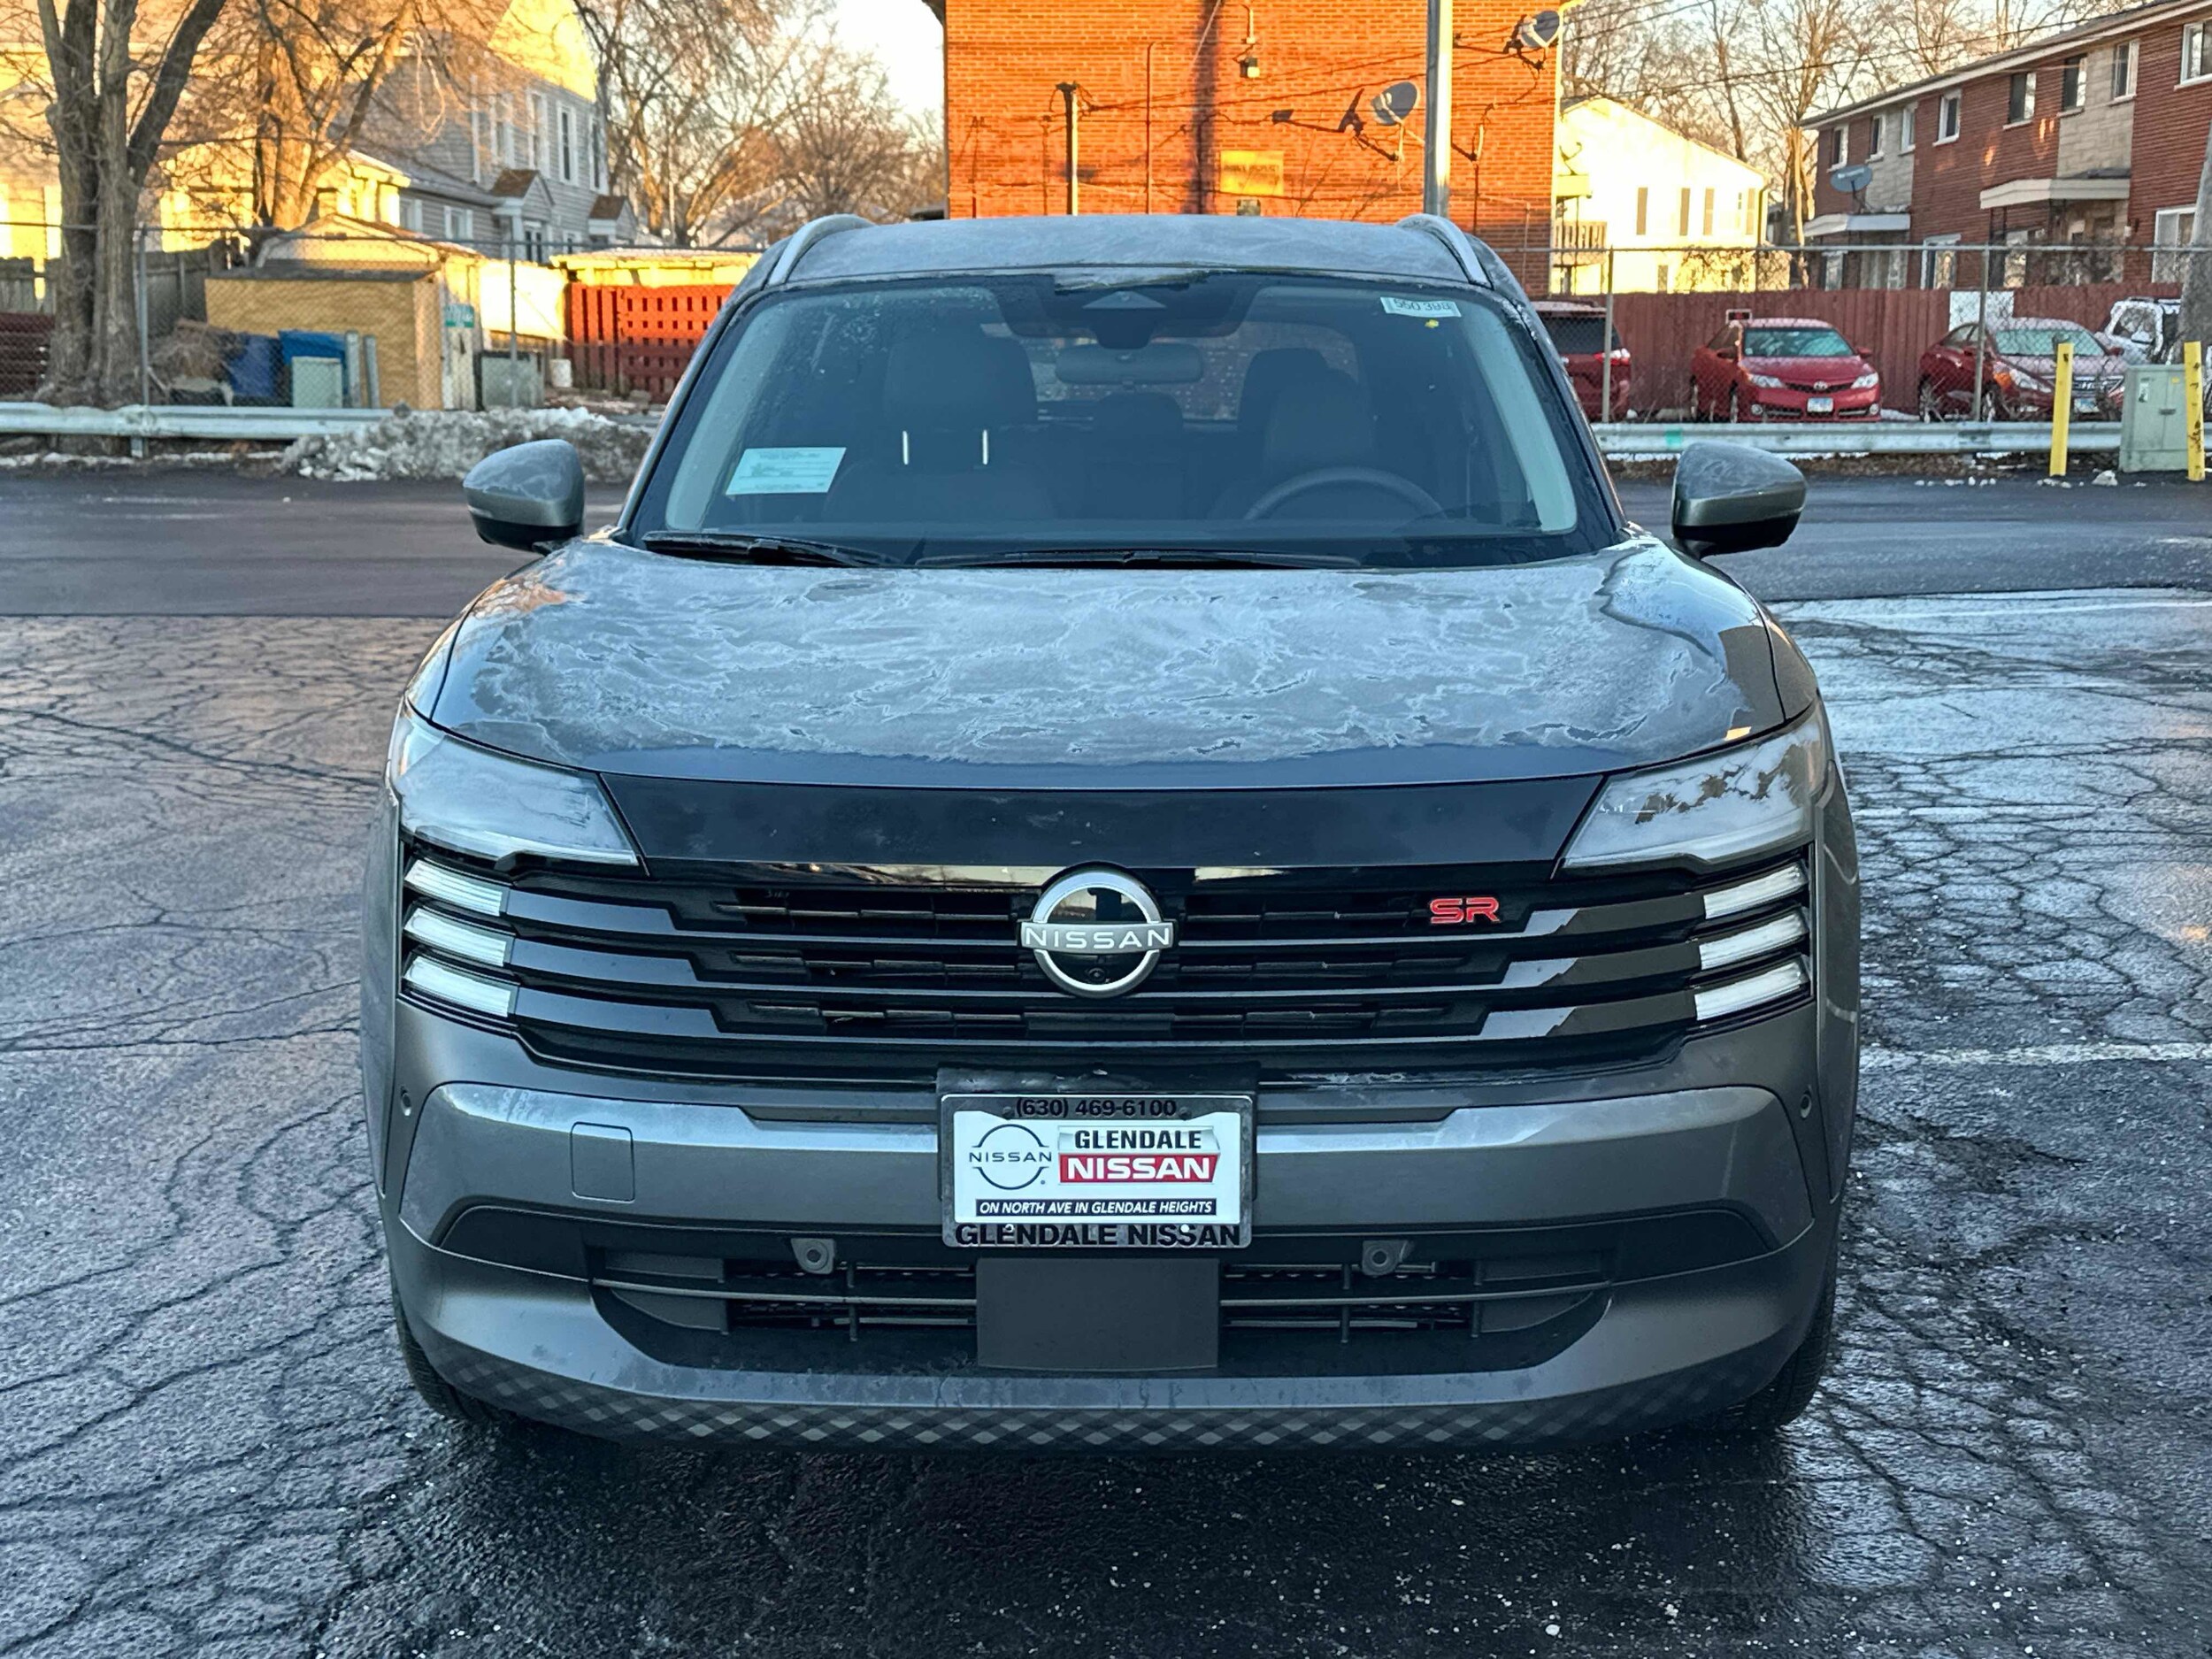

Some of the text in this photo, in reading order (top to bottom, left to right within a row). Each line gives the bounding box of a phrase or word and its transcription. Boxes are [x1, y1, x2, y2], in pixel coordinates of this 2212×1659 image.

[1430, 896, 1502, 924] SR
[1025, 927, 1170, 949] NISSAN
[1017, 1097, 1178, 1118] (630) 469-6100
[1074, 1129, 1202, 1149] GLENDALE
[968, 1152, 1053, 1163] NISSAN
[1067, 1157, 1210, 1179] NISSAN
[979, 1201, 1213, 1214] ON NORTH AVE IN GLENDALE HEIGHTS
[956, 1224, 1240, 1247] GLENDALE NISSAN
